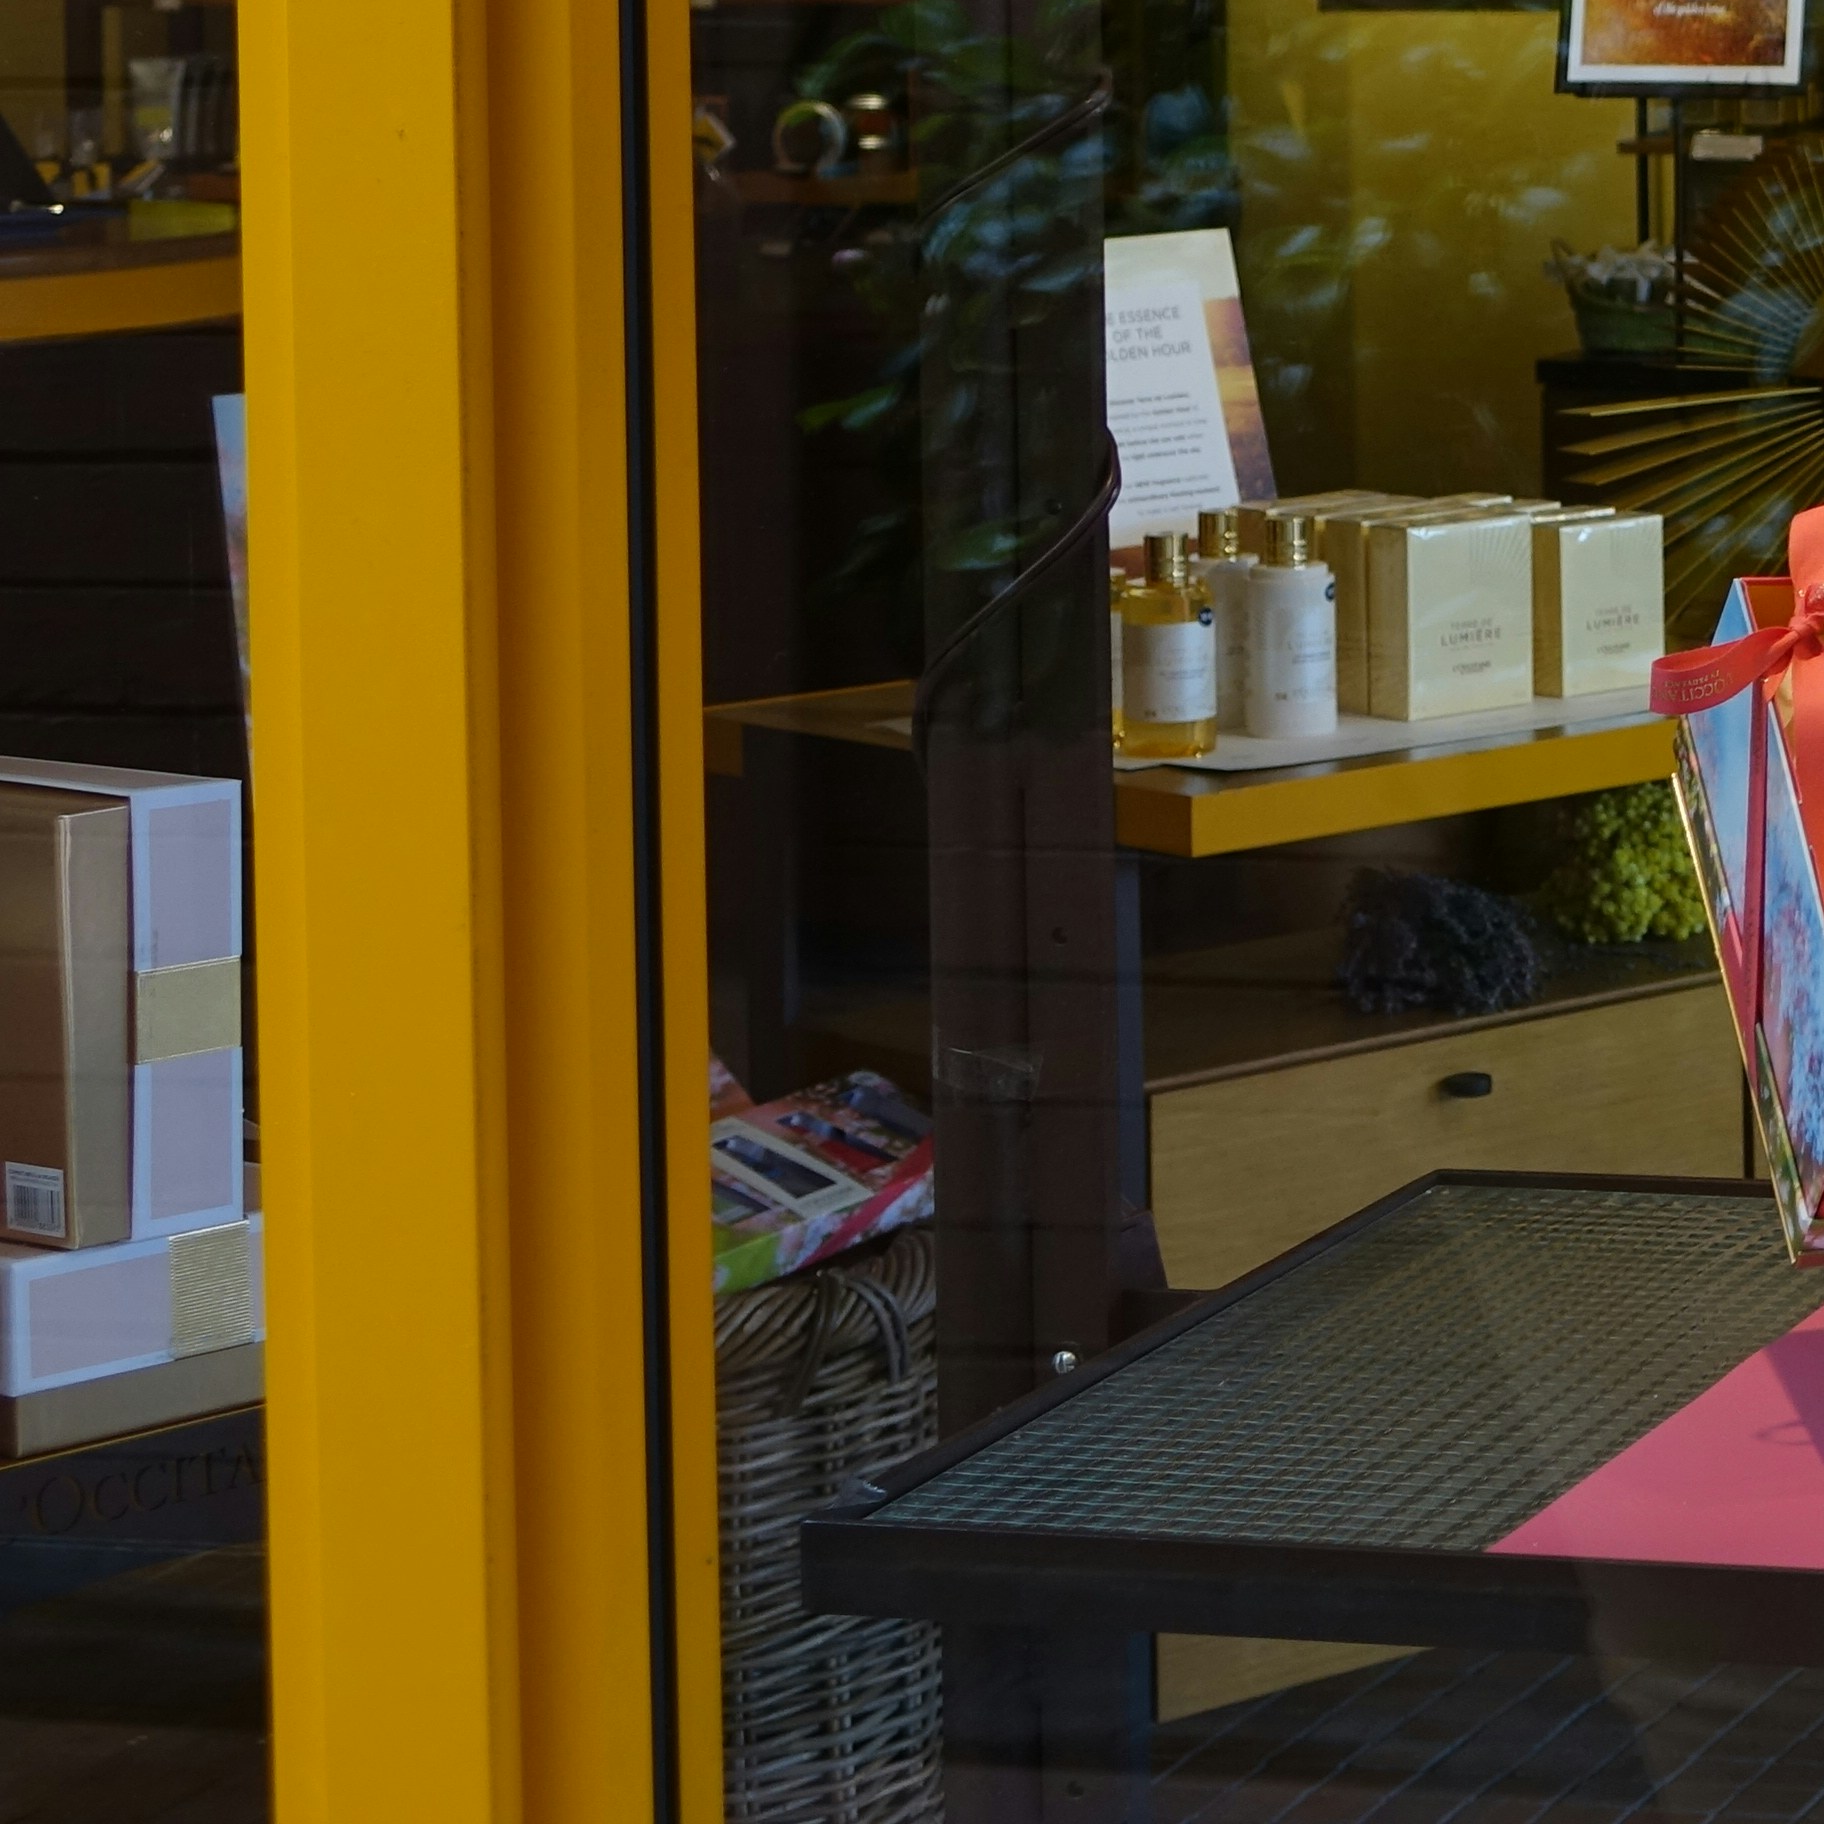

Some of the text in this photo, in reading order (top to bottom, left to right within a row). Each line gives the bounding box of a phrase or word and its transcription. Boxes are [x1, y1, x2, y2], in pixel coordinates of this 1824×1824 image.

[1118, 306, 1180, 325] ESSENCE
[1112, 326, 1163, 344] OF THE
[1151, 341, 1192, 358] HOUR
[1440, 627, 1501, 647] LUMIÈRE
